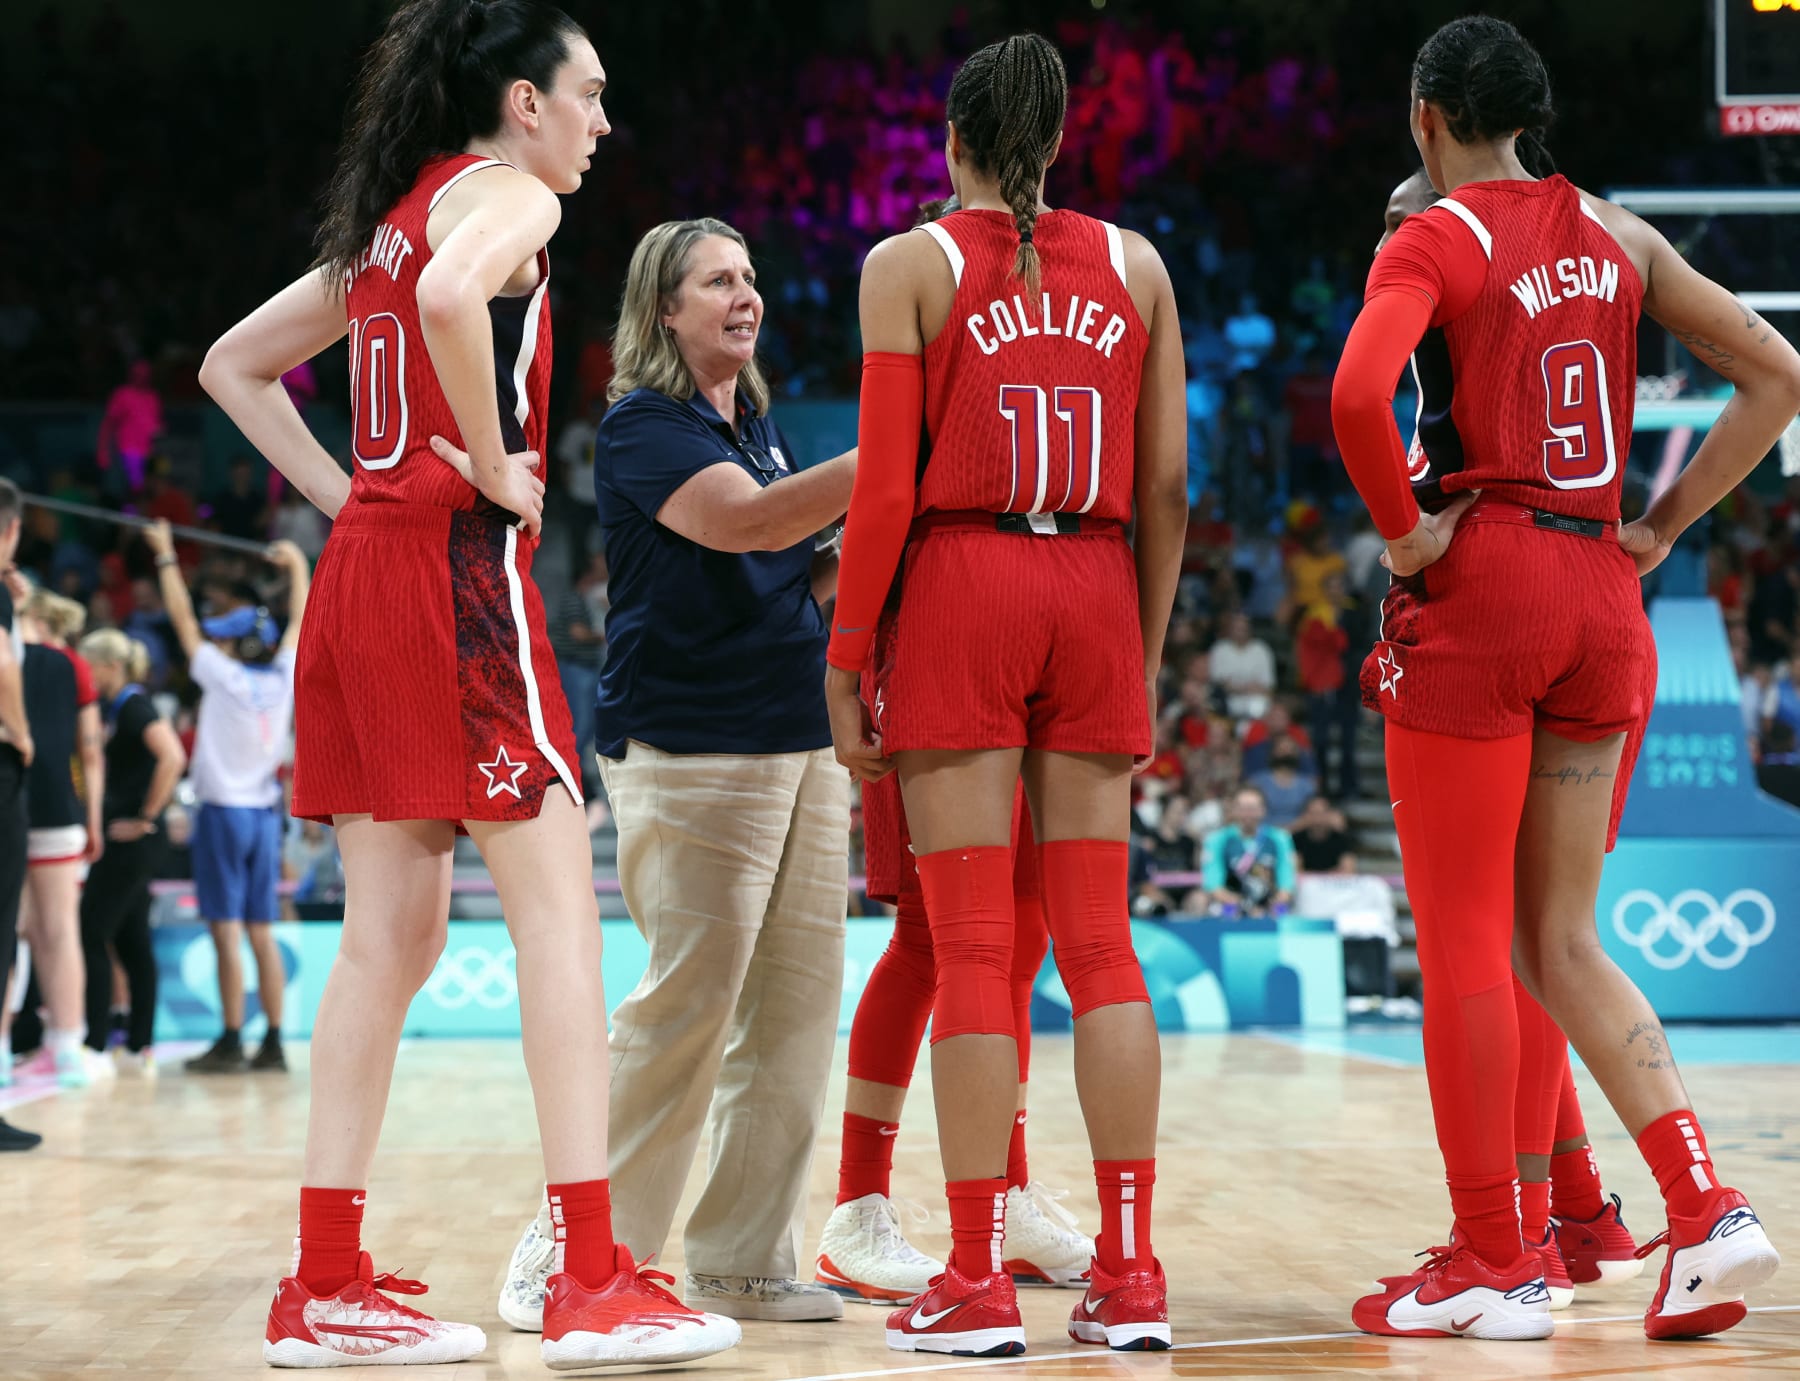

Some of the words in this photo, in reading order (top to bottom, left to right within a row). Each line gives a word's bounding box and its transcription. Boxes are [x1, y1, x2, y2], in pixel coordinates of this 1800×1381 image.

[967, 292, 1126, 359] COLLIER
[1509, 255, 1620, 320] WILSON
[998, 384, 1102, 514] 11
[1540, 339, 1617, 490] 9
